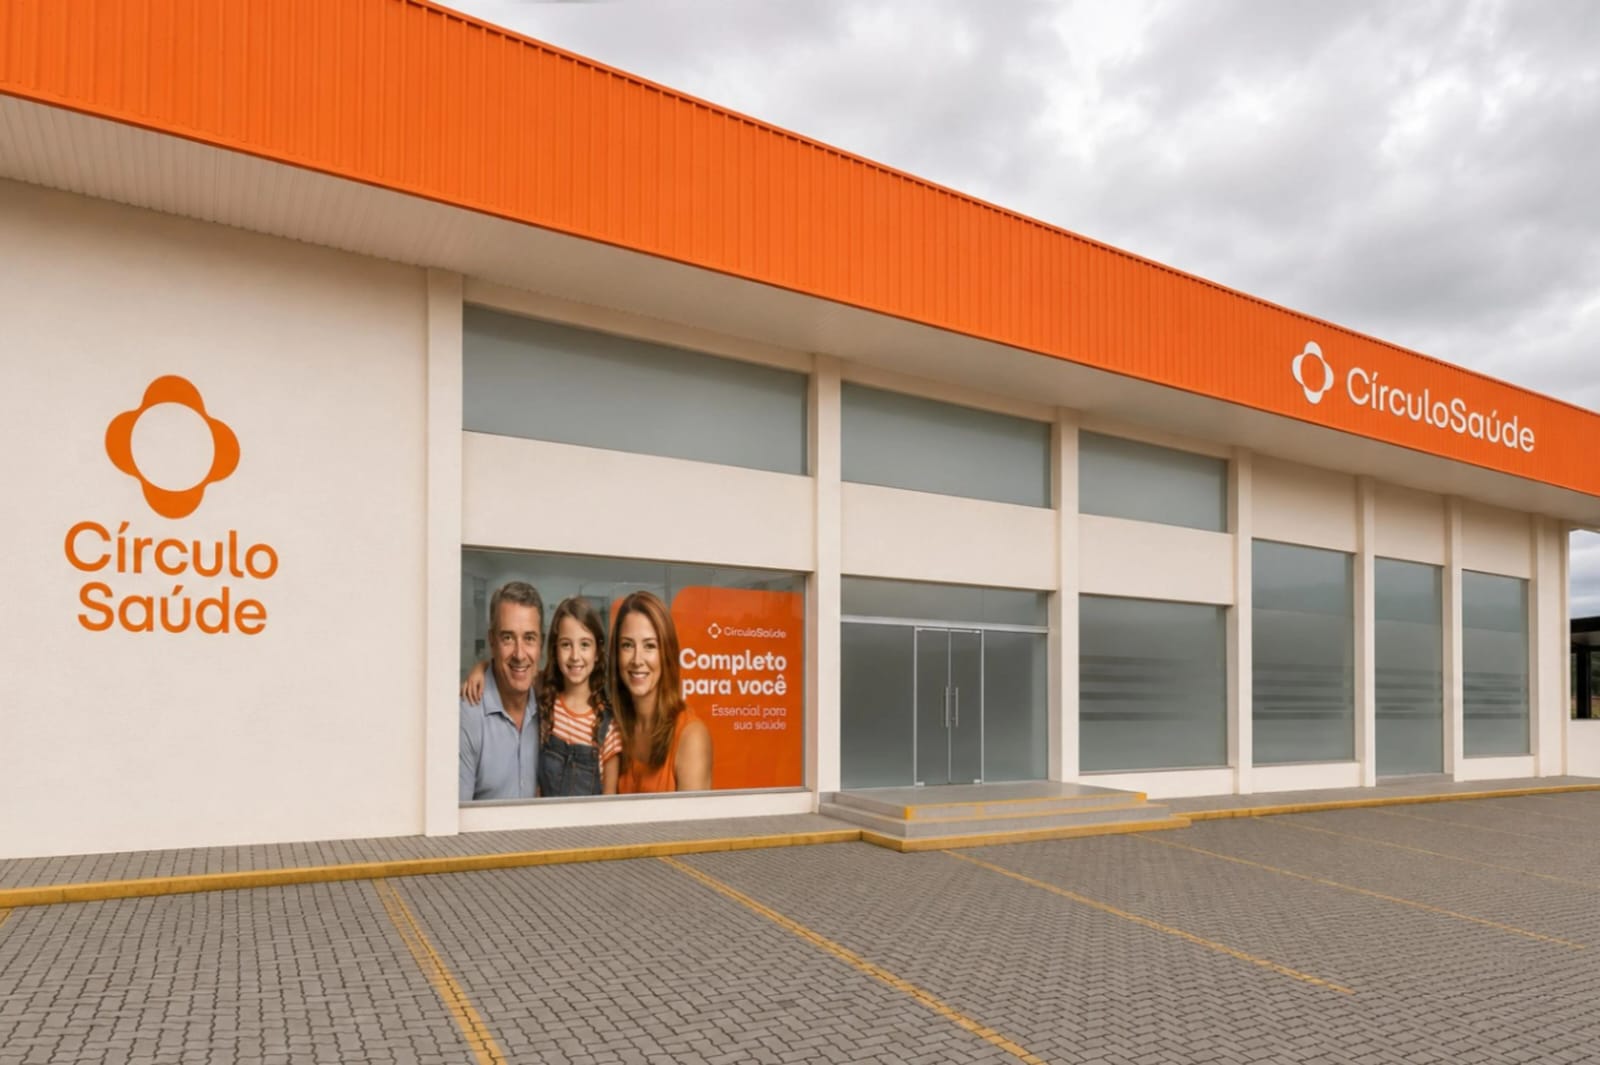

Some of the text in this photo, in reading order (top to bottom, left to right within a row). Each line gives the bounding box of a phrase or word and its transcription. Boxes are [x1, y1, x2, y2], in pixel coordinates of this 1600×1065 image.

[1346, 367, 1535, 453] CírculoSaúde
[64, 520, 279, 580] Círculo
[78, 581, 268, 635] Saúde
[679, 648, 787, 676] Completo
[682, 674, 787, 700] para você
[711, 704, 786, 718] Essencial para
[733, 720, 753, 730] sua
